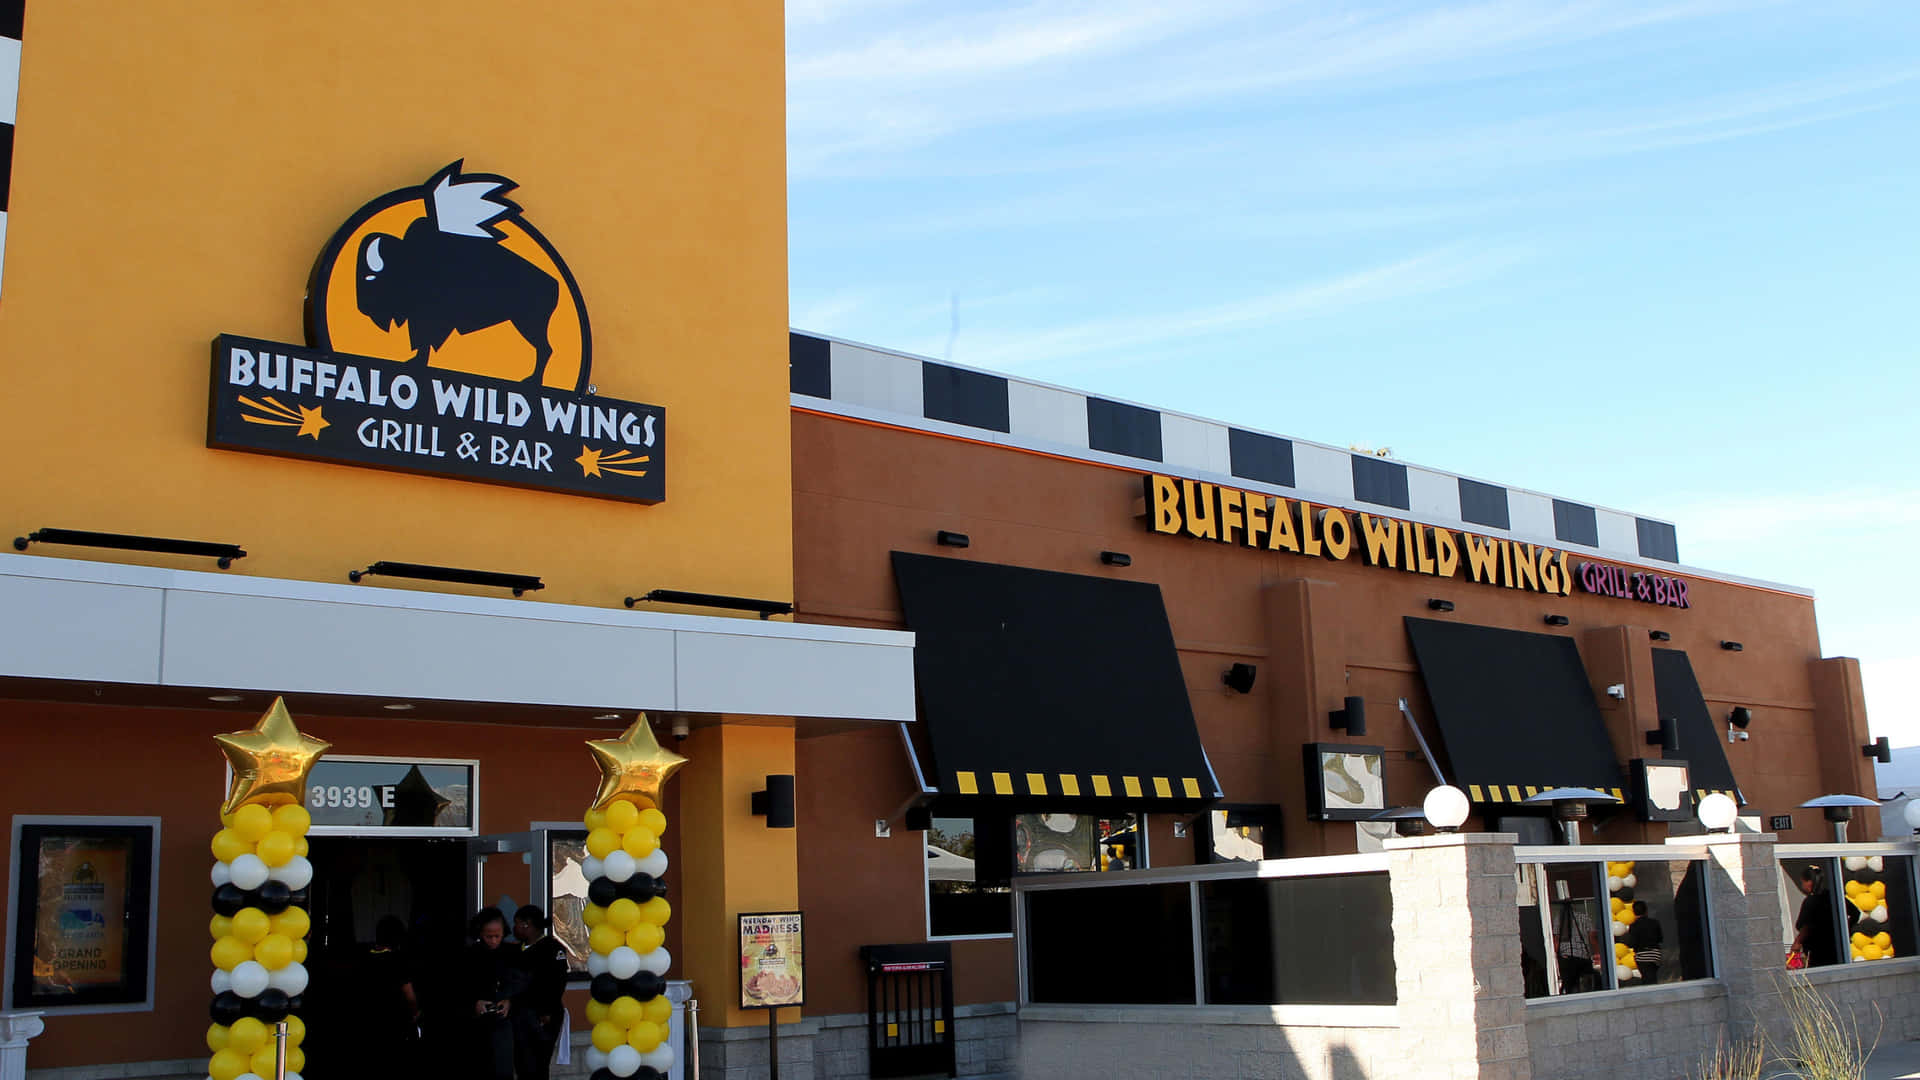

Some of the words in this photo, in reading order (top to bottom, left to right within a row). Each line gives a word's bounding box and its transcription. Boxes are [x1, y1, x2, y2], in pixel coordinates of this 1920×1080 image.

[229, 347, 419, 410] BUFFALO
[431, 379, 532, 427] WILD
[541, 397, 656, 447] WINGS
[357, 417, 446, 458] GRILL
[456, 431, 481, 463] &
[490, 435, 553, 473] BAR
[1152, 474, 1351, 560] BUFFALO
[1359, 512, 1459, 577] WILD
[1464, 532, 1572, 596] WINGS
[1581, 562, 1633, 599] GRILL
[1637, 571, 1652, 601] &
[1653, 574, 1691, 609] BAR
[311, 785, 372, 808] 3939
[382, 786, 395, 808] E
[1774, 816, 1790, 829] EXIT
[743, 923, 800, 935] MADNESS
[54, 959, 107, 970] OPENING
[57, 948, 103, 959] GRAND
